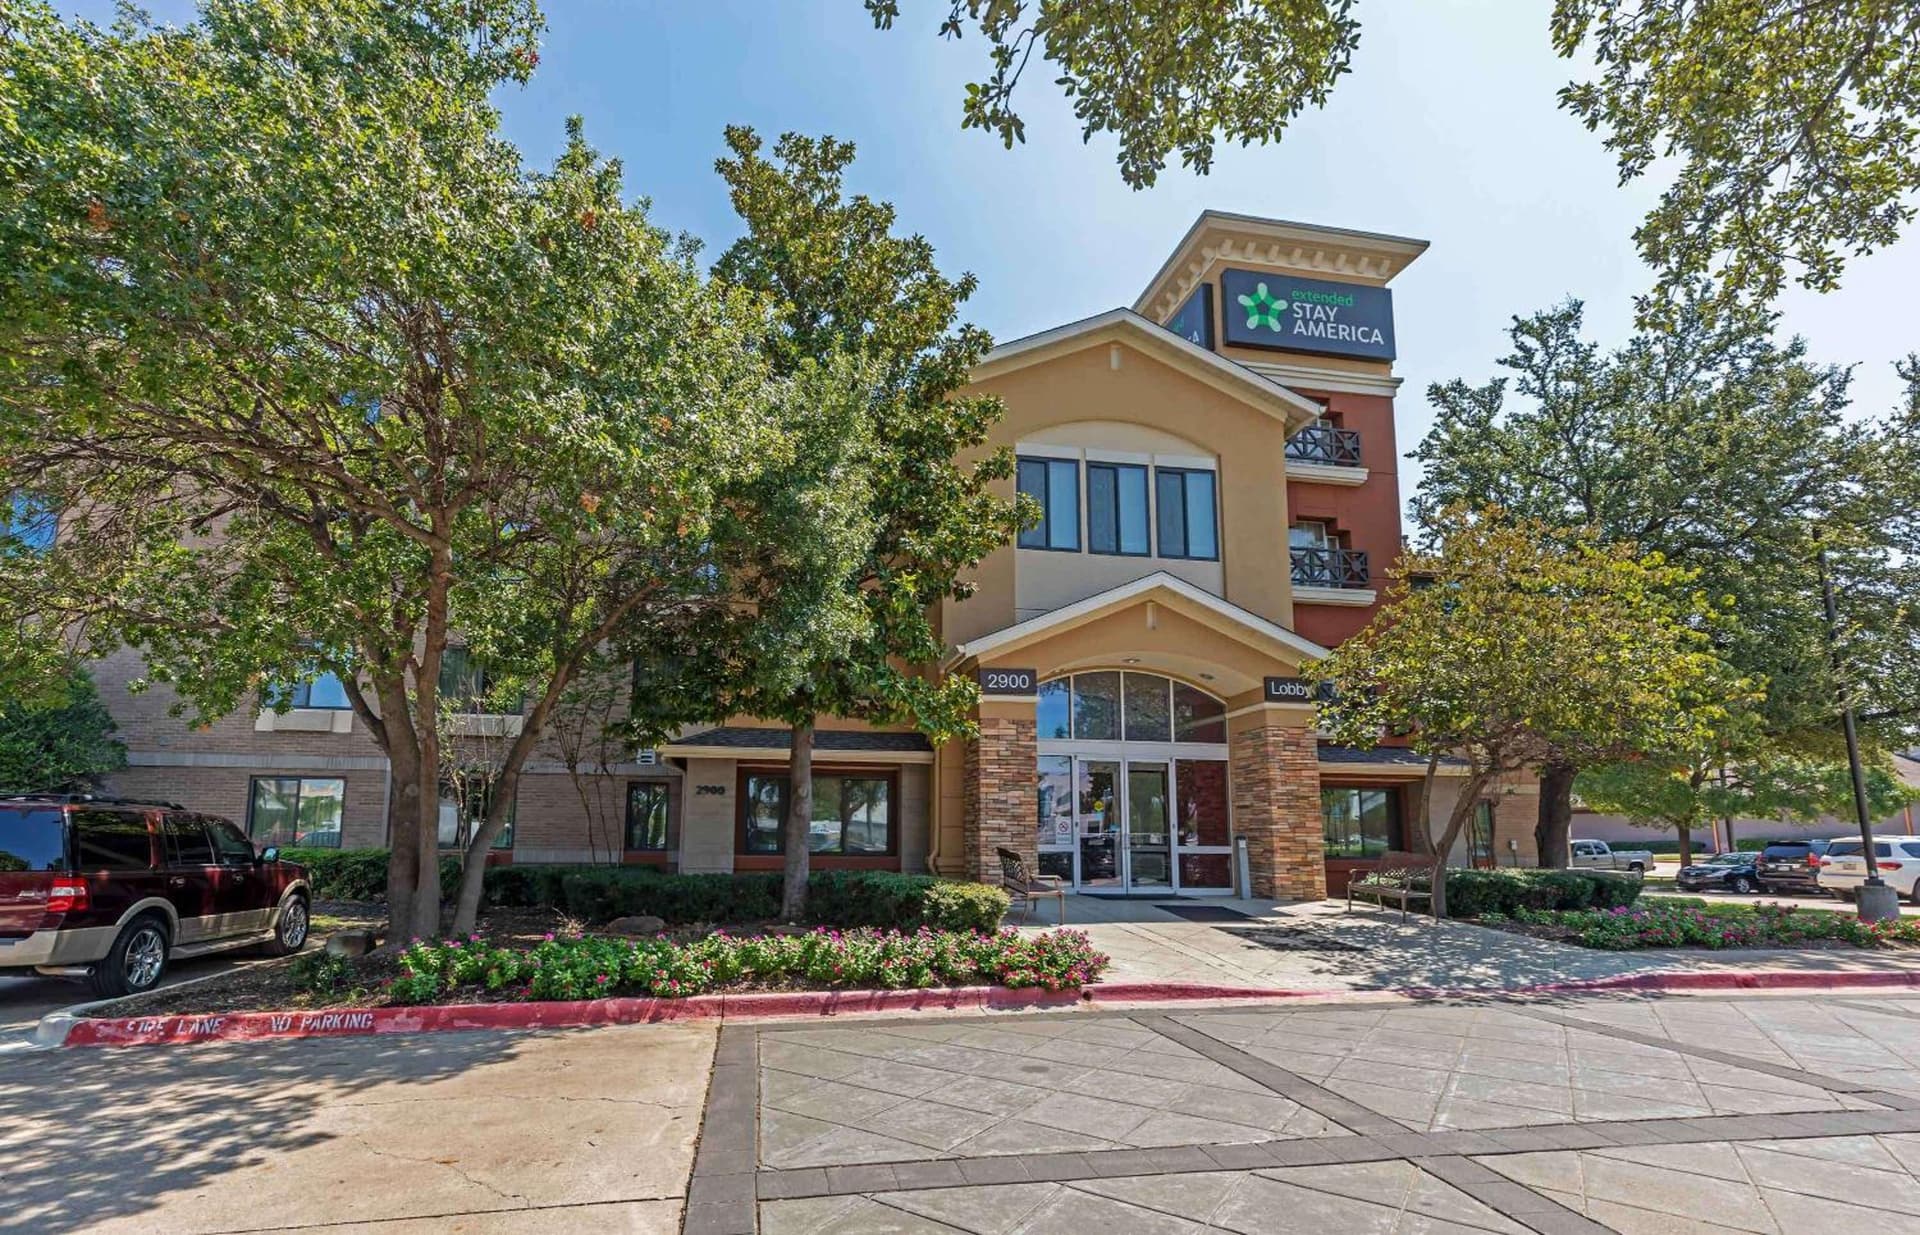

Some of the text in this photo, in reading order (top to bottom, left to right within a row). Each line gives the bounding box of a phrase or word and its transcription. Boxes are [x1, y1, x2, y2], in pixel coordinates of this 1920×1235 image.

[1291, 288, 1354, 306] extended
[1292, 301, 1338, 322] STAY
[1293, 319, 1385, 345] AMERICA
[988, 673, 1029, 689] 2900
[695, 784, 726, 796] 2900
[176, 1017, 226, 1035] LANE
[270, 1014, 292, 1032] NO
[299, 1012, 374, 1032] PARKING
